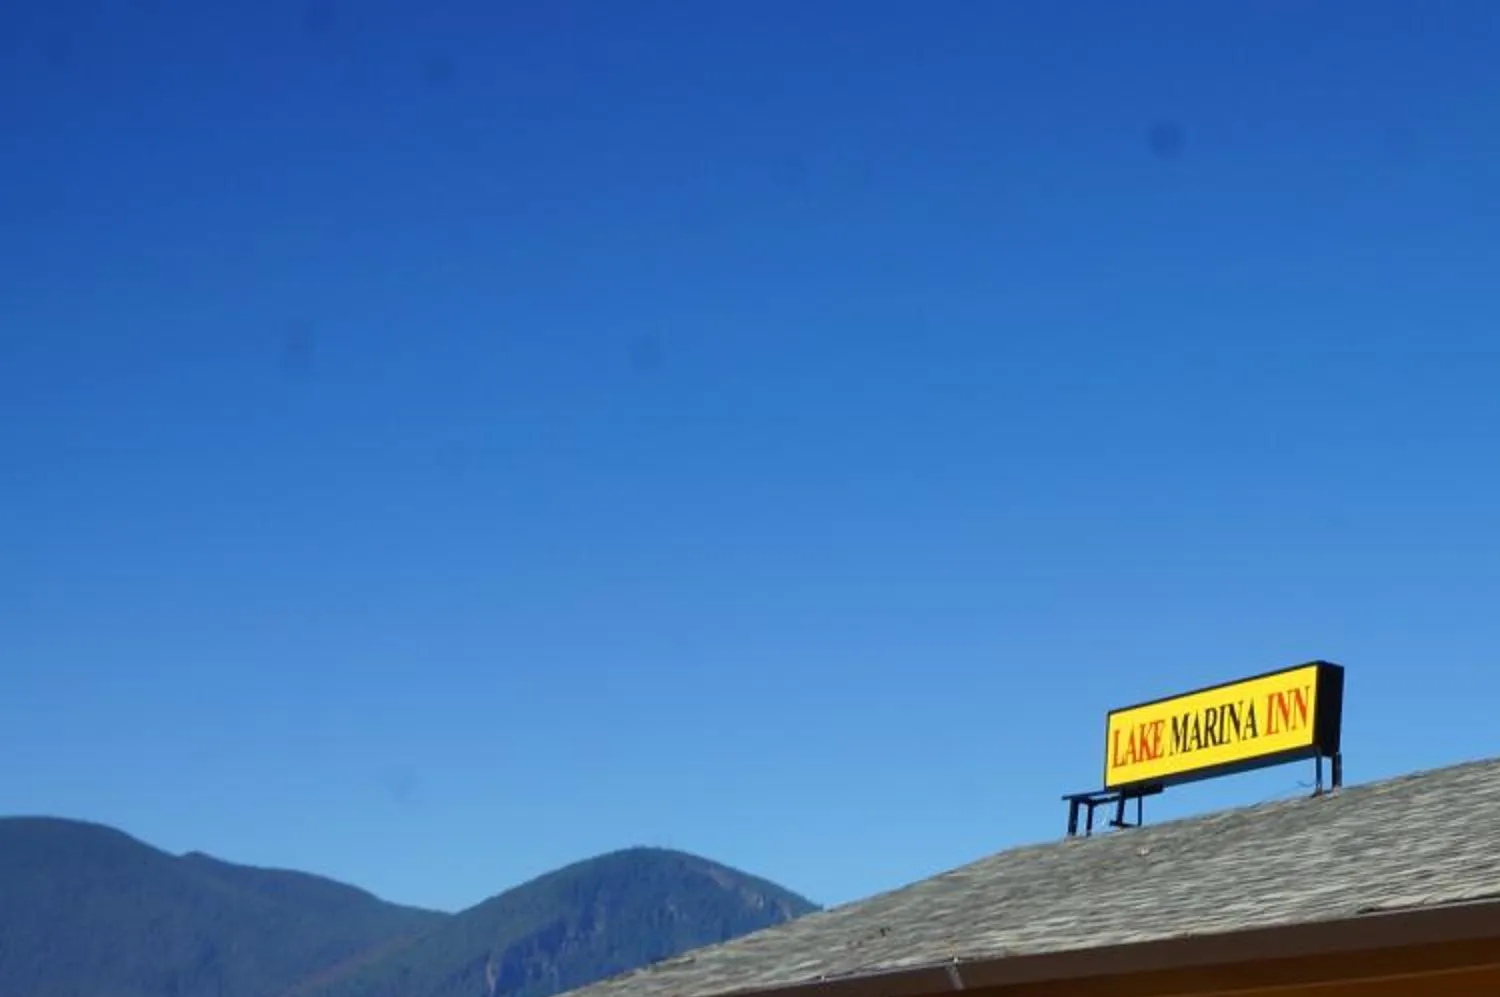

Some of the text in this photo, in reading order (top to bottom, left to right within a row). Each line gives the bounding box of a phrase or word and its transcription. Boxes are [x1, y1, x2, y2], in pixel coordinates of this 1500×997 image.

[1112, 686, 1311, 768] LAKE MARINA INN
